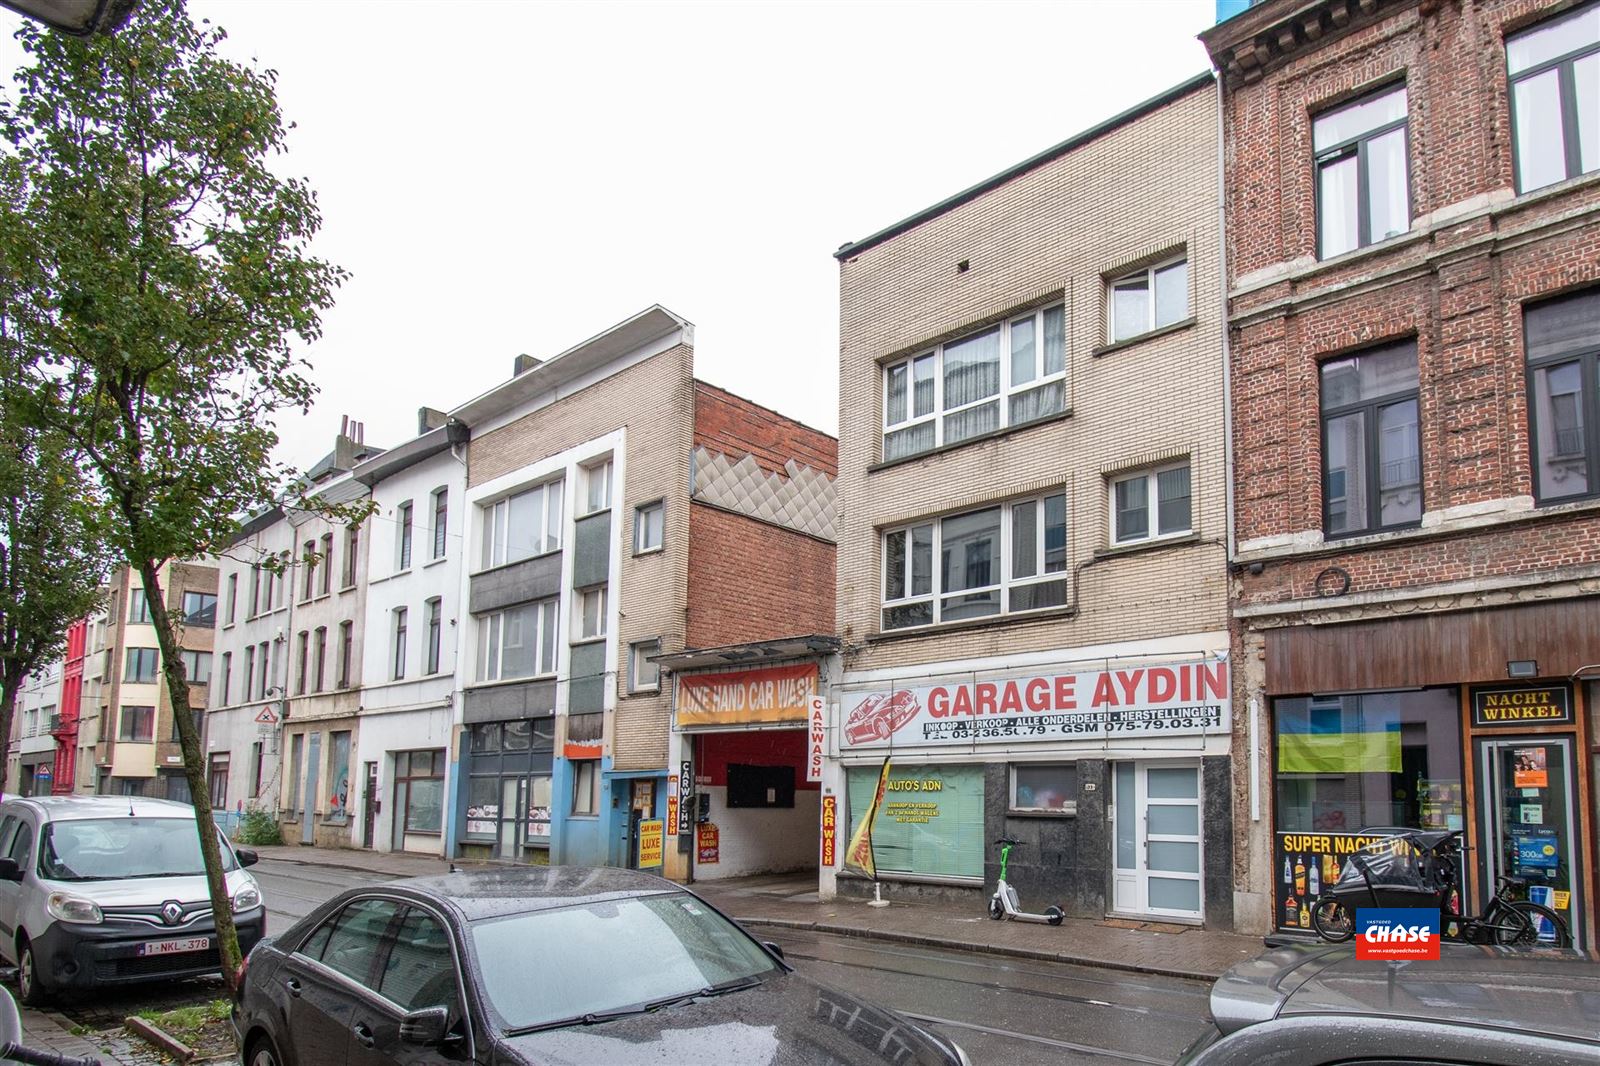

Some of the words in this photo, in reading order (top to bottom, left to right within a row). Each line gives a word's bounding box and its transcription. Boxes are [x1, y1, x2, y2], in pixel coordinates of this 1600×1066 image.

[681, 686, 711, 713] LUXE
[713, 683, 746, 712] HAND
[748, 680, 774, 711] CAR
[777, 676, 815, 709] WASH
[927, 675, 1077, 719] GARAGE
[1091, 662, 1228, 708] AYDIN
[1486, 692, 1550, 706] NACHT
[925, 721, 959, 732] INKOOP
[965, 717, 1009, 730] VERKOOP
[1016, 715, 1040, 727] ALLE
[1042, 710, 1112, 726] ONDERDELEN
[1120, 706, 1216, 721] HERSTELLINGEN
[1483, 705, 1561, 720] WINKEL
[1061, 723, 1098, 735] GSM
[888, 780, 919, 791] AUTO'S
[922, 780, 942, 791] ADN
[669, 804, 677, 835] WASH
[824, 798, 834, 827] CAR
[641, 825, 650, 833] CAR
[651, 824, 662, 832] WASH
[642, 837, 660, 850] LUXE
[700, 839, 717, 848] WASH
[824, 829, 834, 865] WASH
[1284, 835, 1331, 853] SUPER
[640, 851, 661, 861] SERVICE
